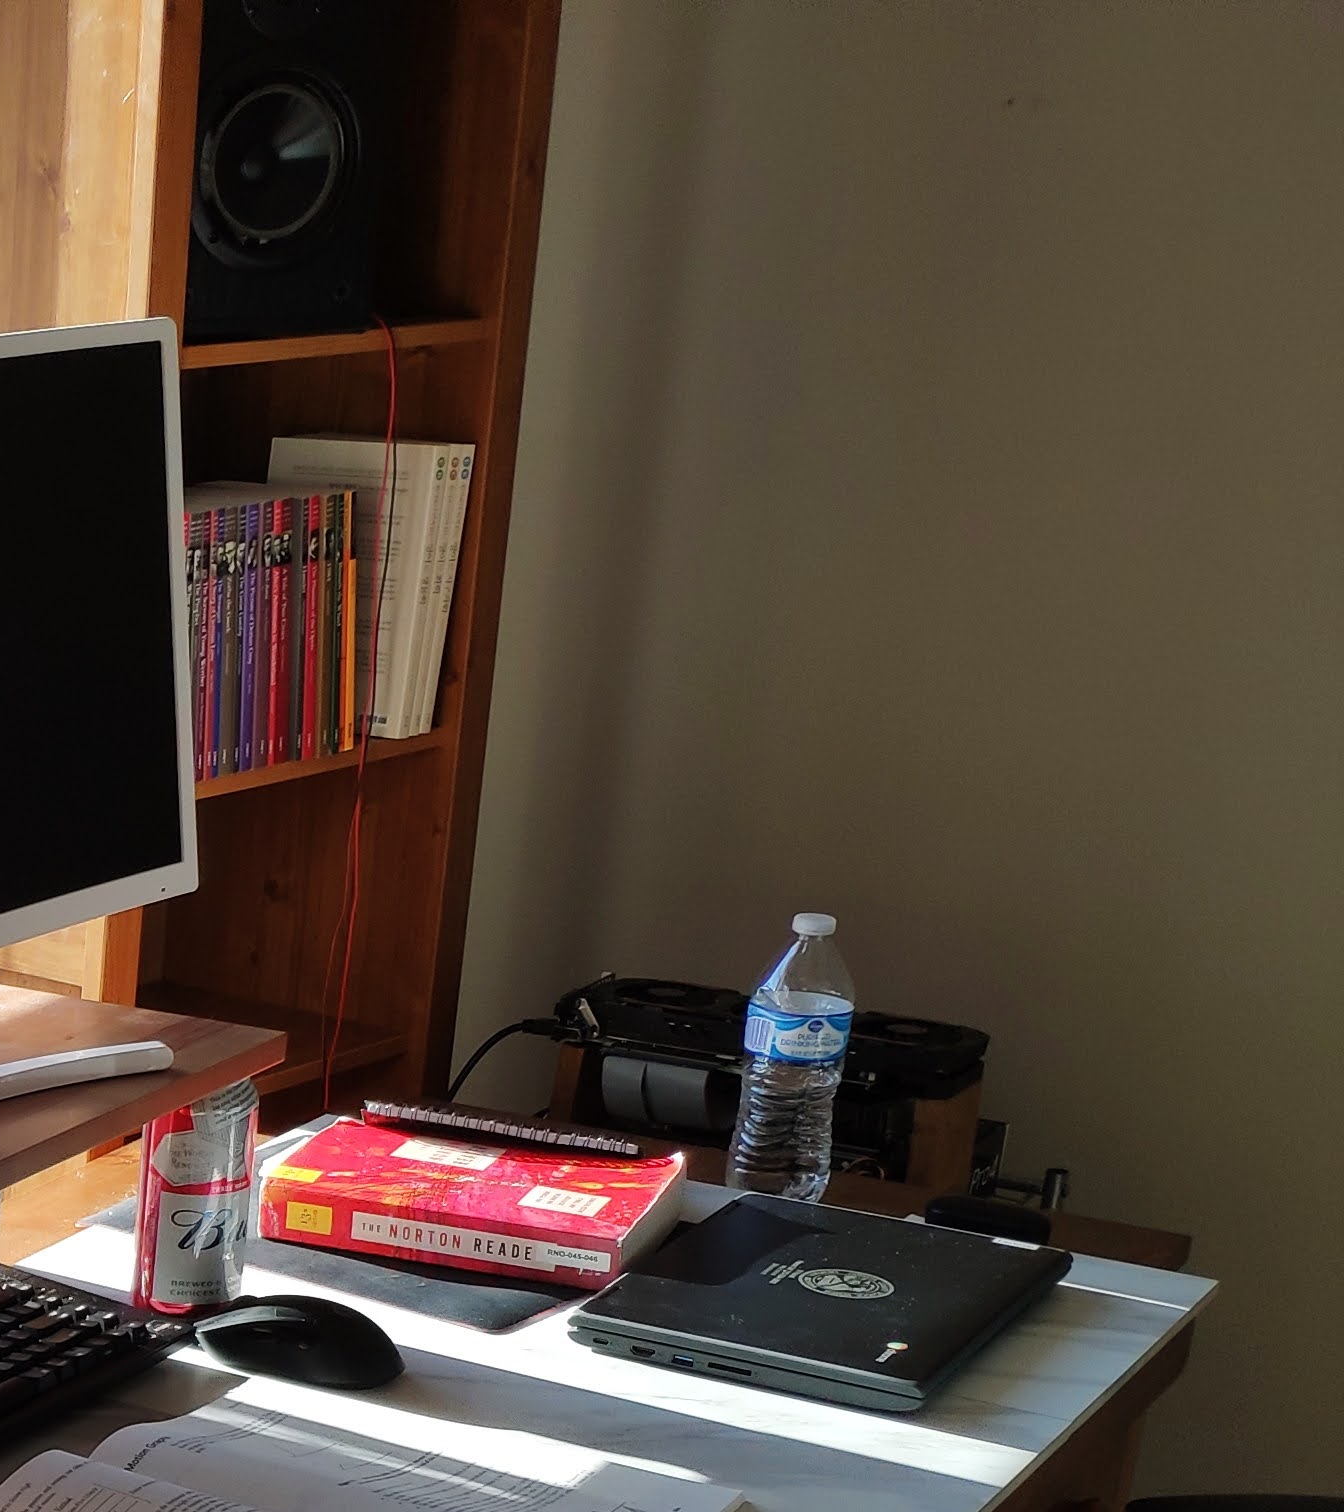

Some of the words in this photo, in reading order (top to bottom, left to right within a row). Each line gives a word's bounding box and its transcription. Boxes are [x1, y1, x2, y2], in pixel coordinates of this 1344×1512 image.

[361, 1222, 381, 1234] THE
[388, 1223, 462, 1250] NORTON
[473, 1235, 534, 1262] READE
[123, 1448, 150, 1472] Motion
